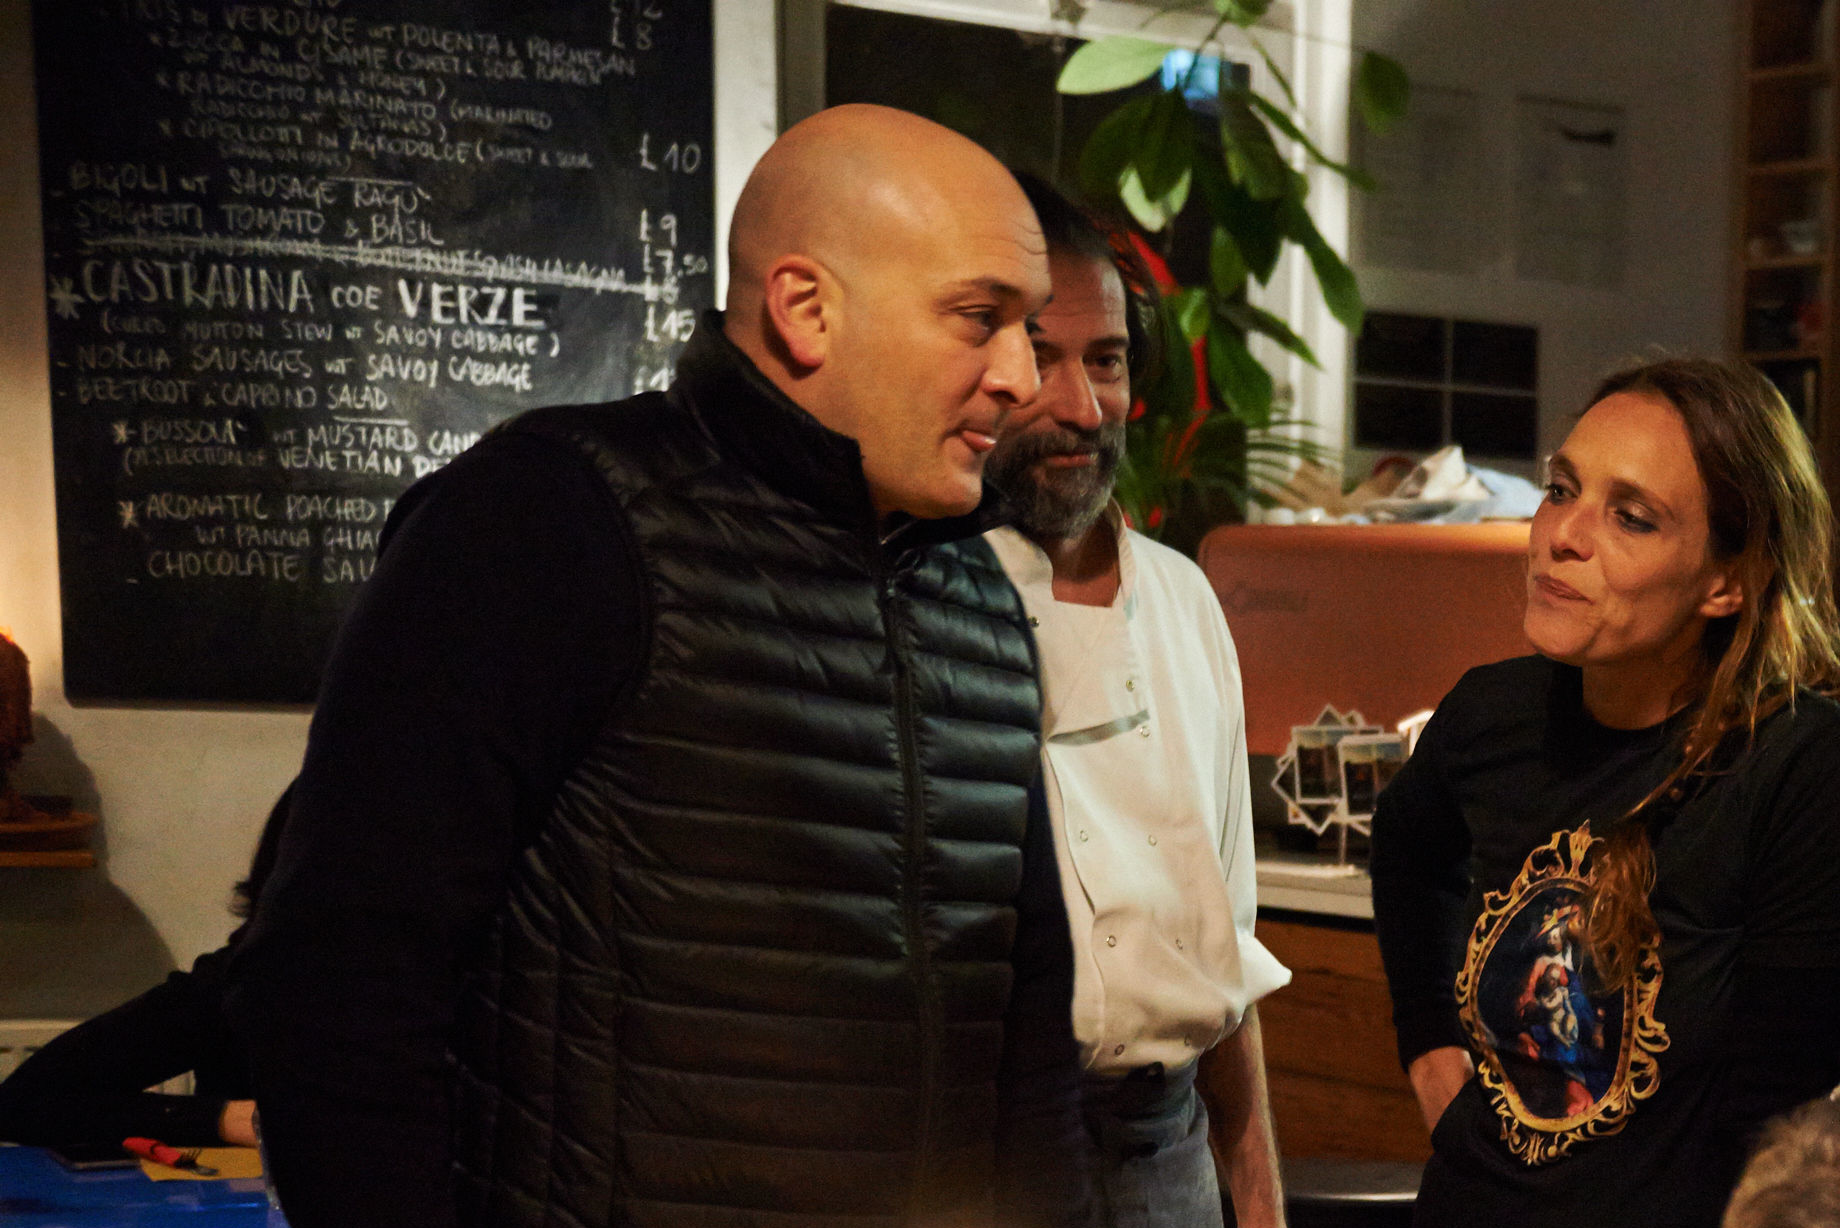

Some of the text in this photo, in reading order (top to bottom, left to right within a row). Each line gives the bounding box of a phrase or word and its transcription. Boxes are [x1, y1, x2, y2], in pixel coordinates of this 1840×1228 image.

[222, 5, 357, 43] VERDURE
[402, 22, 500, 54] POLENTA
[314, 87, 438, 121] MARINATO
[69, 160, 167, 198] BIGOLI
[228, 167, 337, 208] SAUSAGE
[219, 203, 326, 234] TOMATO
[370, 213, 445, 246] BASIL
[80, 258, 316, 314] CASTRADINA
[396, 277, 546, 330] VERZE
[180, 320, 264, 341] MUTTON
[281, 318, 334, 343] STEW
[372, 318, 441, 350] SAVOY
[191, 345, 313, 381] SAUSAGES
[365, 352, 439, 388] SAVOY
[447, 355, 534, 393] CABBAGE
[76, 376, 195, 405] BEETROOT
[326, 385, 388, 411] SALAD
[306, 424, 418, 453] MUSTARD
[277, 446, 402, 477] VENETIAN
[147, 493, 270, 521] AROMATIC
[286, 493, 377, 524] POACHED
[235, 526, 311, 549] PANNA
[148, 549, 301, 583] CHOCOLATE
